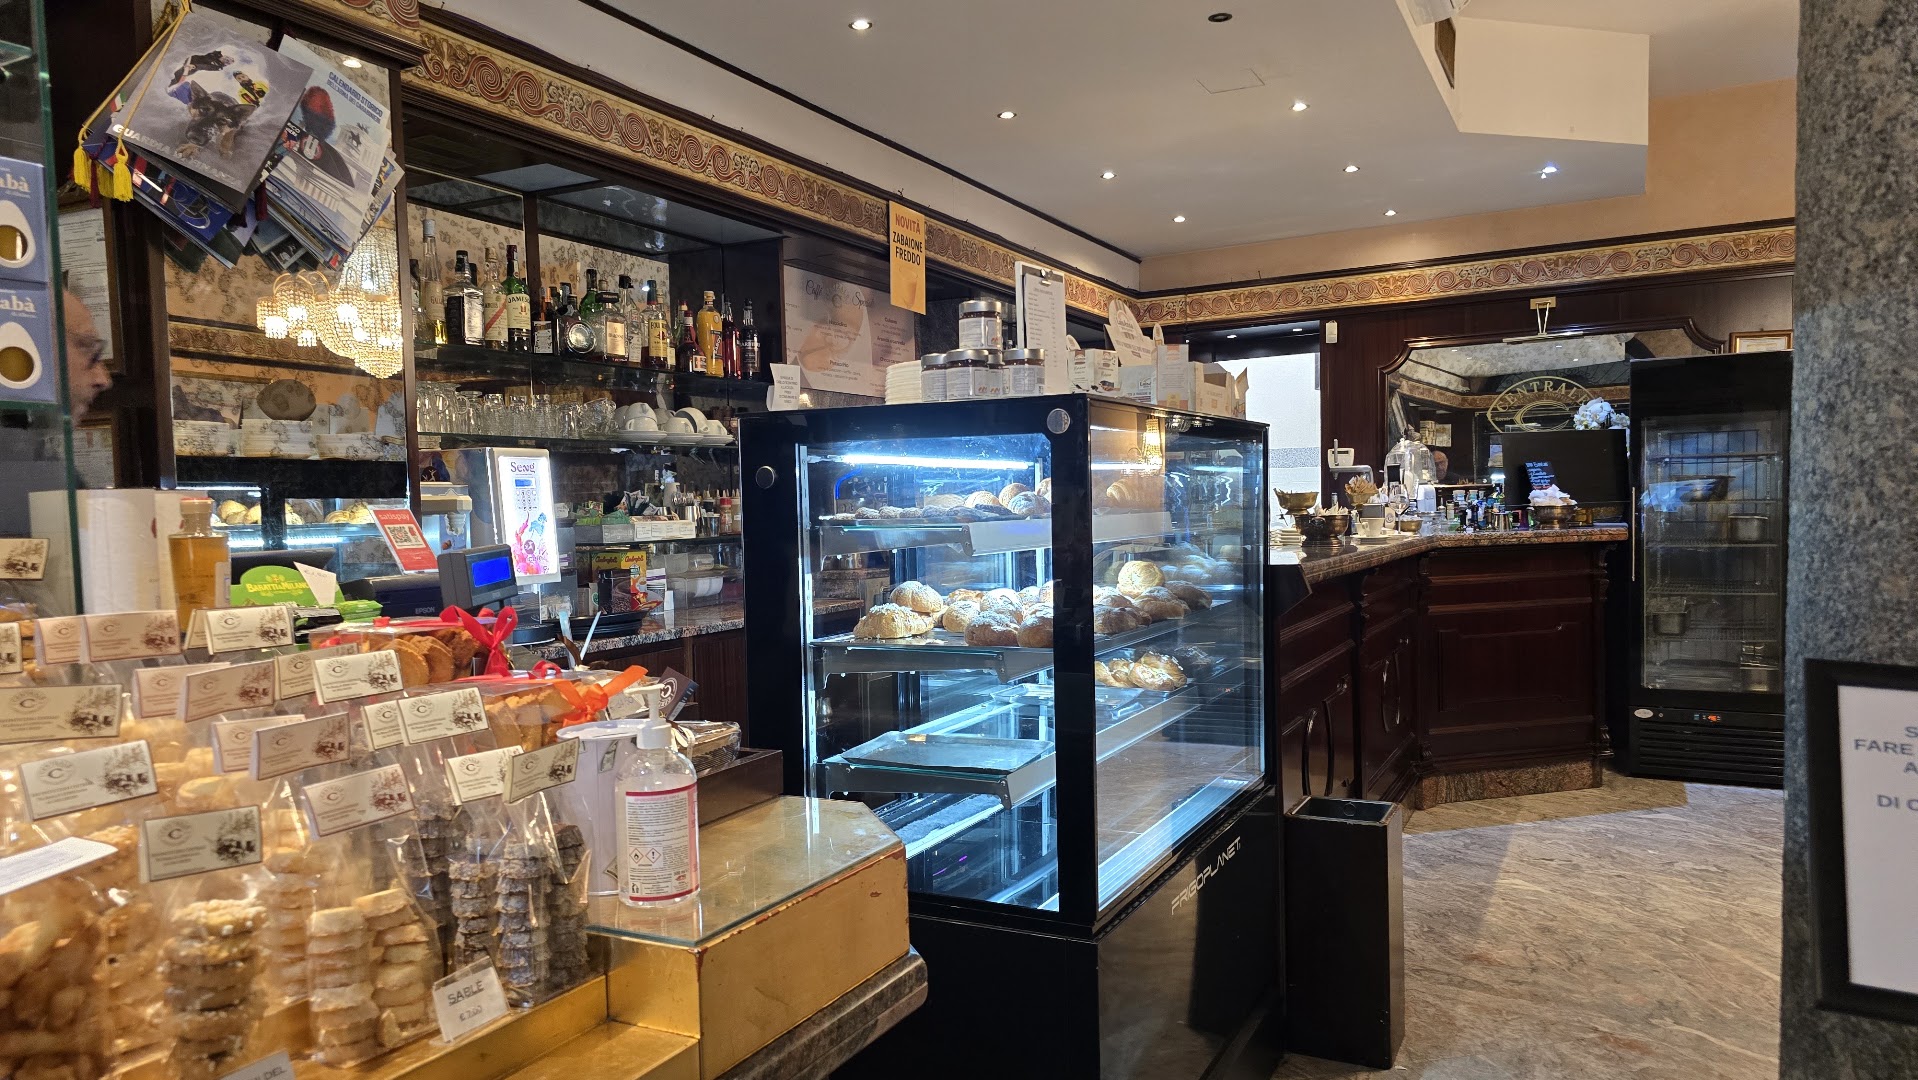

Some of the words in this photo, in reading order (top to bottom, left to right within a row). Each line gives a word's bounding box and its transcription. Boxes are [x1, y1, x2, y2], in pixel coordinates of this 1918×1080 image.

[329, 71, 361, 101] CALENDARIO
[360, 96, 383, 117] STORICO
[112, 123, 171, 154] GUARDIA
[895, 213, 921, 235] NOVITÀ
[892, 231, 923, 253] ZABAIONE
[895, 246, 921, 266] FREDDO
[1496, 380, 1592, 413] CENTRALE
[379, 512, 410, 521] satispay
[415, 606, 436, 615] EPSON
[1853, 738, 1915, 757] FARE
[1876, 794, 1900, 810] DI
